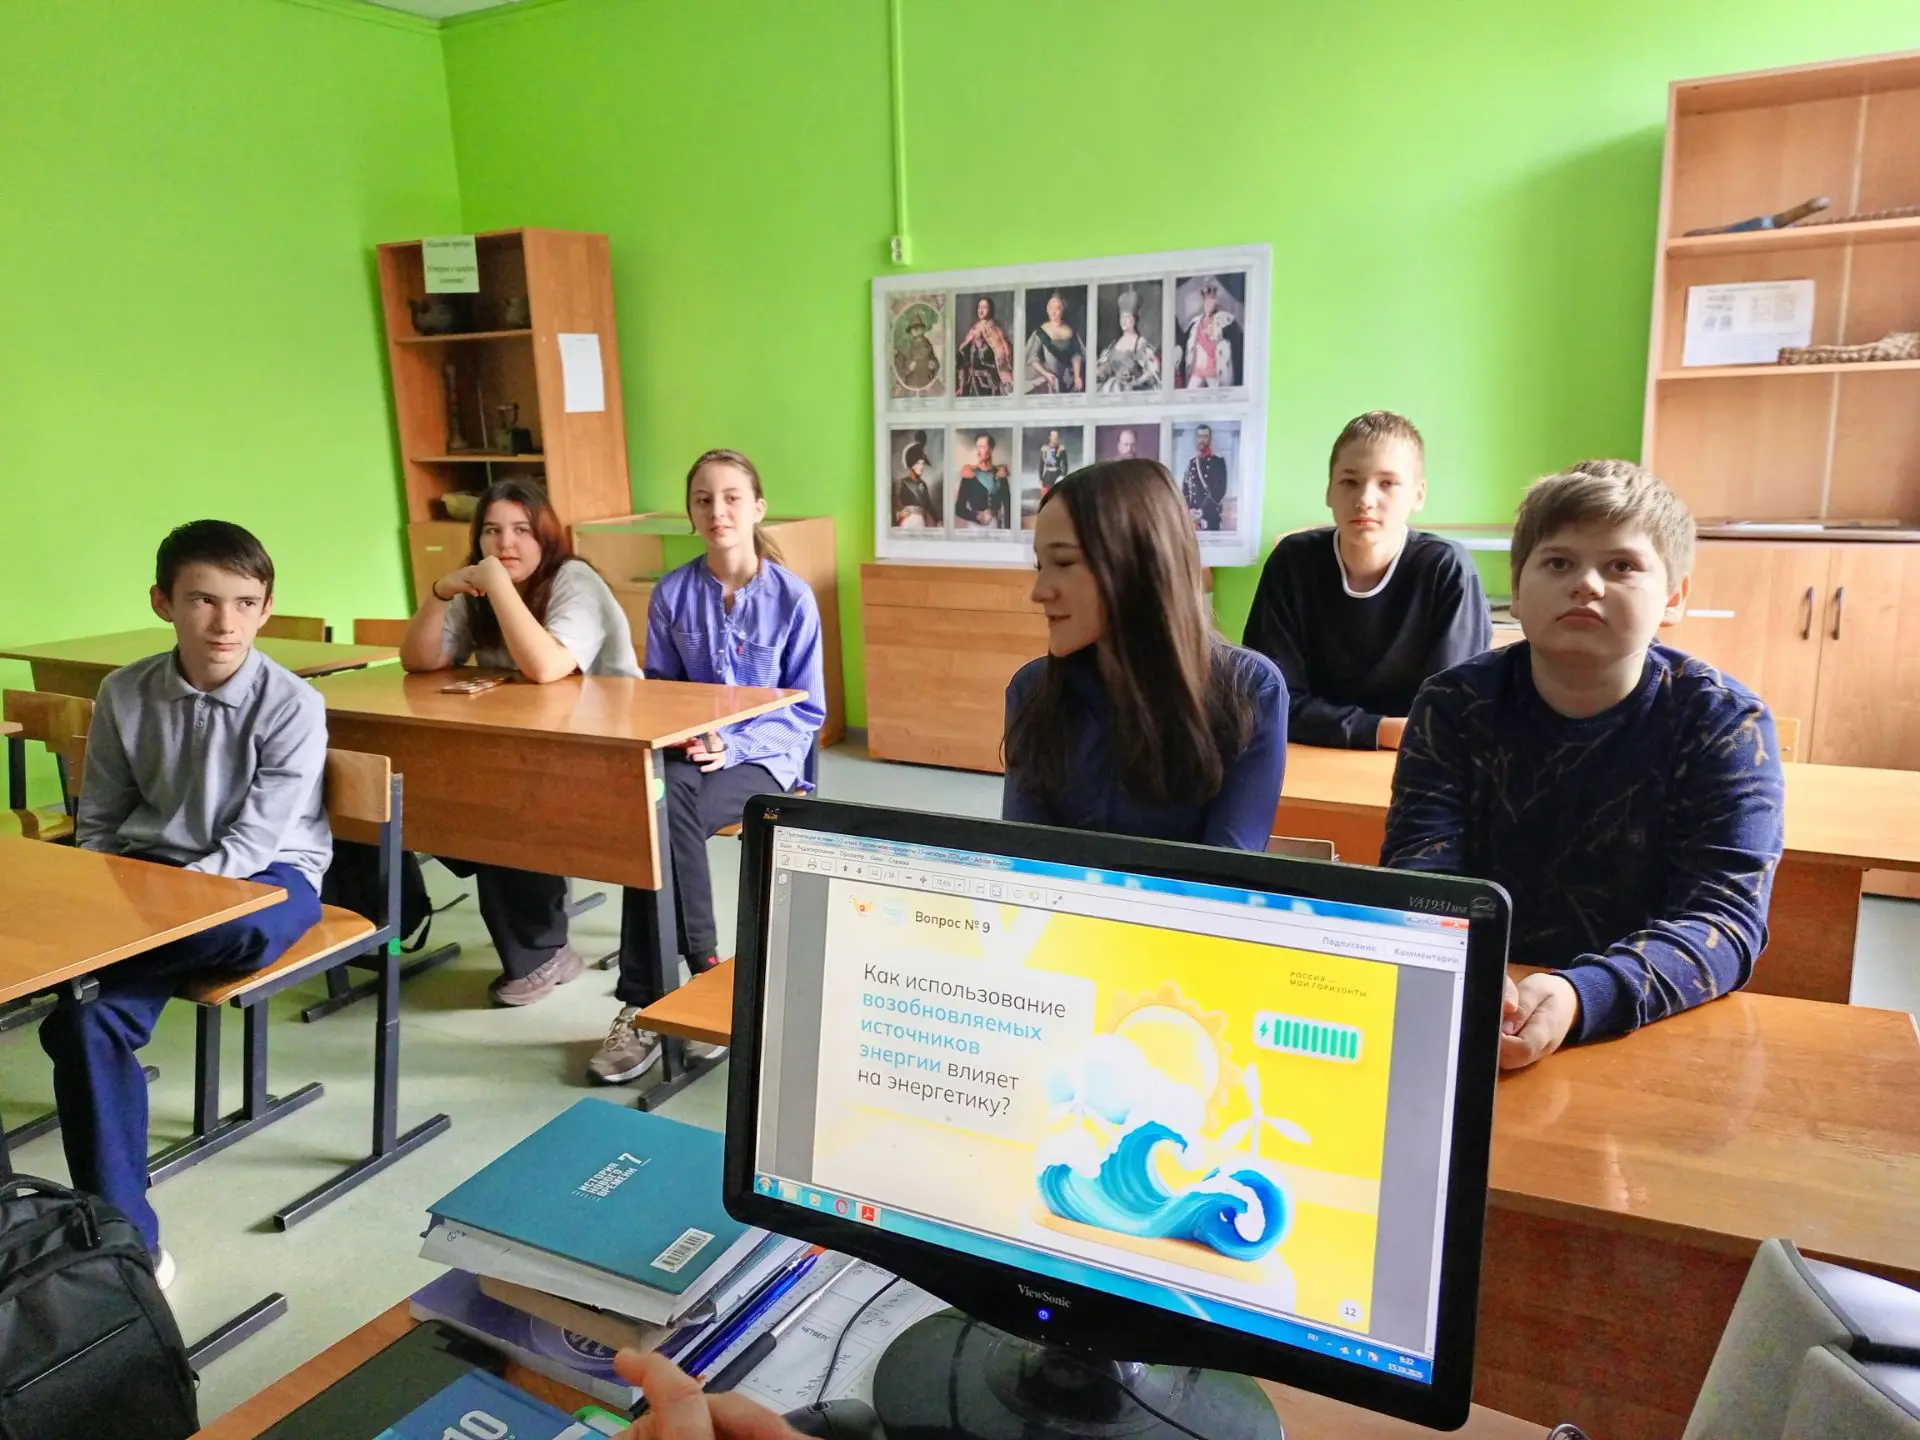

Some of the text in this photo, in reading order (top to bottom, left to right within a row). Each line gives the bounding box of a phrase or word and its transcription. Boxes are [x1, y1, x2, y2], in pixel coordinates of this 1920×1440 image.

[915, 911, 961, 928] Вопрос
[982, 922, 990, 933] 9
[1322, 936, 1377, 952] Подписание
[1394, 948, 1460, 964] Комментарии
[1289, 979, 1367, 997] МОИ ГОРИЗОНТЫ
[1290, 971, 1325, 982] РОССИЯ
[864, 963, 1066, 1018] Как использование
[863, 993, 1042, 1041] возобновляемых
[861, 1019, 980, 1055] источников
[859, 1043, 1020, 1090] энергии влияет
[858, 1069, 1011, 1117] на энергетику?
[617, 1152, 643, 1165] 7
[578, 1162, 619, 1192] ИСТОРИЯ
[587, 1168, 624, 1195] НОВОГО
[596, 1167, 639, 1198] ВРЕМЕНИ
[1017, 1283, 1072, 1308] ViewSonic
[1344, 1307, 1356, 1317] 12
[801, 1326, 830, 1342] ЧЕТВЕРГ
[1307, 1333, 1319, 1342] RU
